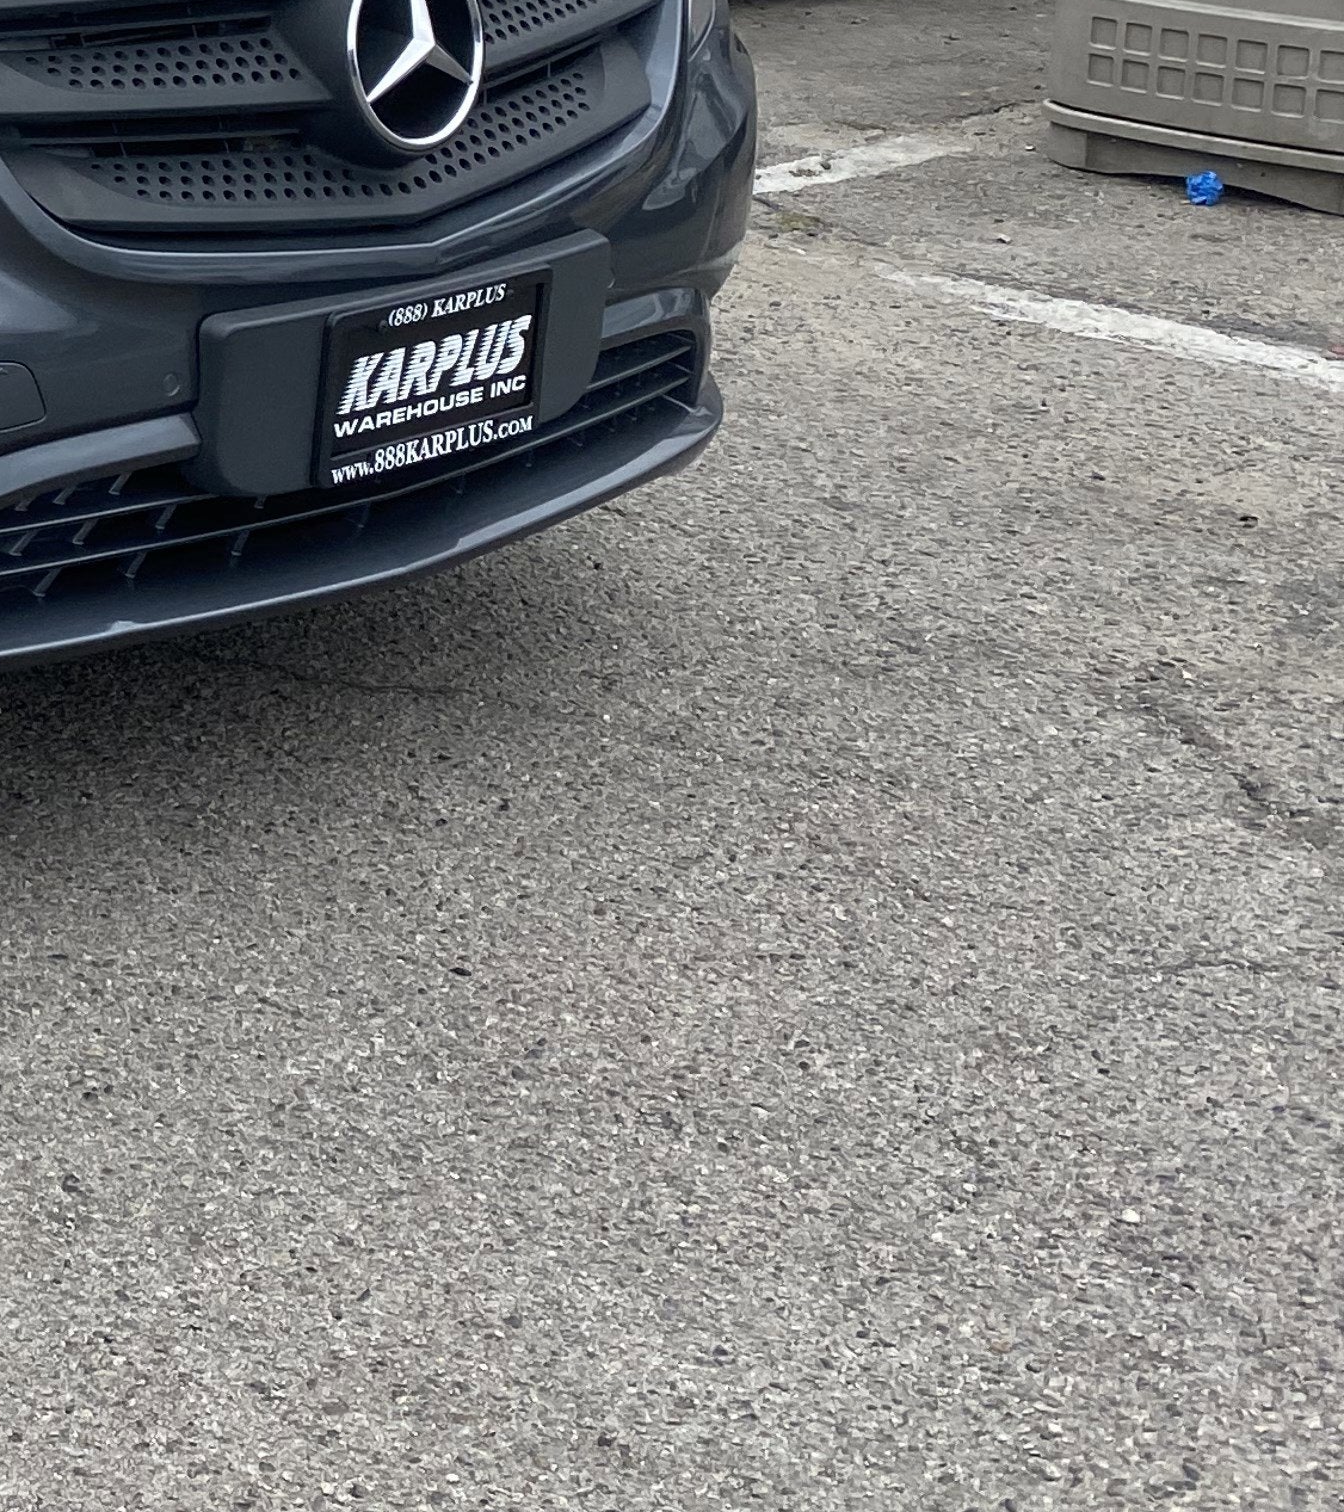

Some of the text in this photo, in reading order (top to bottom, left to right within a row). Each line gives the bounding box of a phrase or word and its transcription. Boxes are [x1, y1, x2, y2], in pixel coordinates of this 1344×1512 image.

[388, 283, 506, 327] (888) KARPLUS
[335, 314, 532, 414] KARPLUS
[333, 374, 527, 438] WAREHOUSE INC
